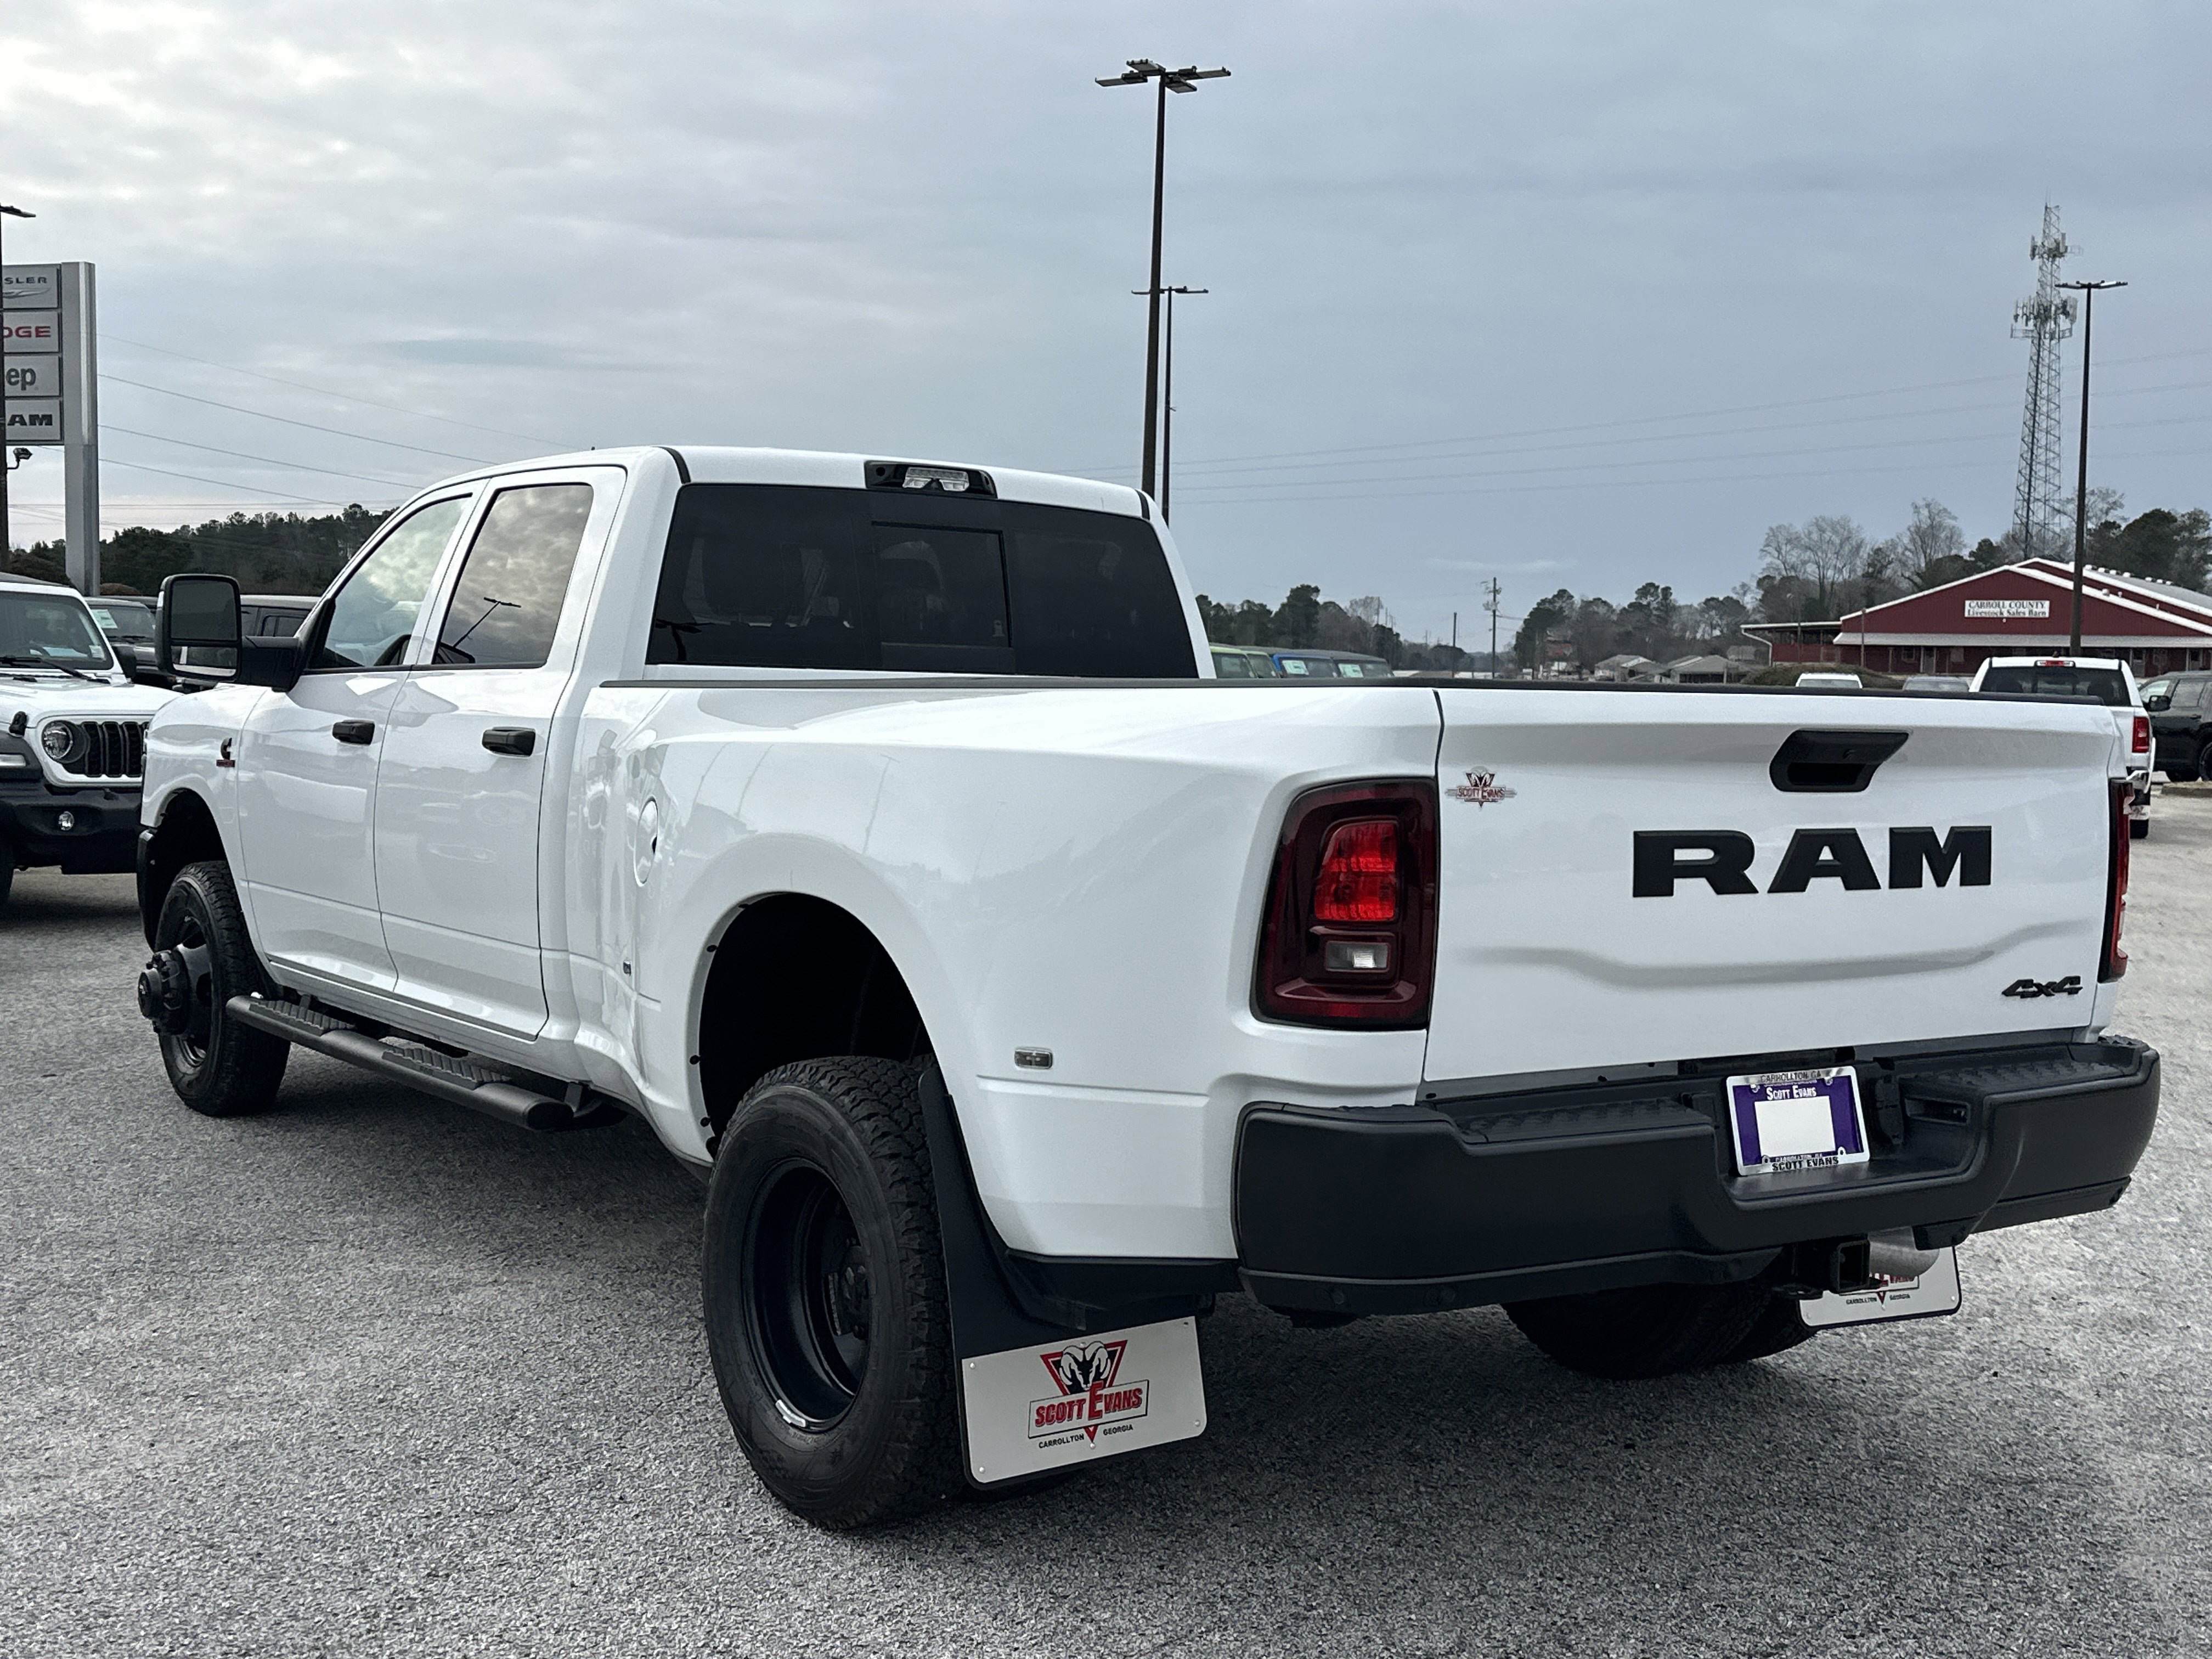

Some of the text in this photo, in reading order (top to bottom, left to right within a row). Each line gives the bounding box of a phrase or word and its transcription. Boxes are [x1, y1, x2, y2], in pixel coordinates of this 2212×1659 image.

[7, 414, 53, 426] AM
[1969, 601, 2046, 609] CARROLL COUNTY
[1632, 826, 1993, 898] RAM
[2001, 975, 2084, 998] 4x4
[1771, 1156, 1839, 1171] SCOTT EVANS
[1035, 1398, 1086, 1427] SCOTT
[1039, 1424, 1134, 1448] CARROLLTON GEORGIA
